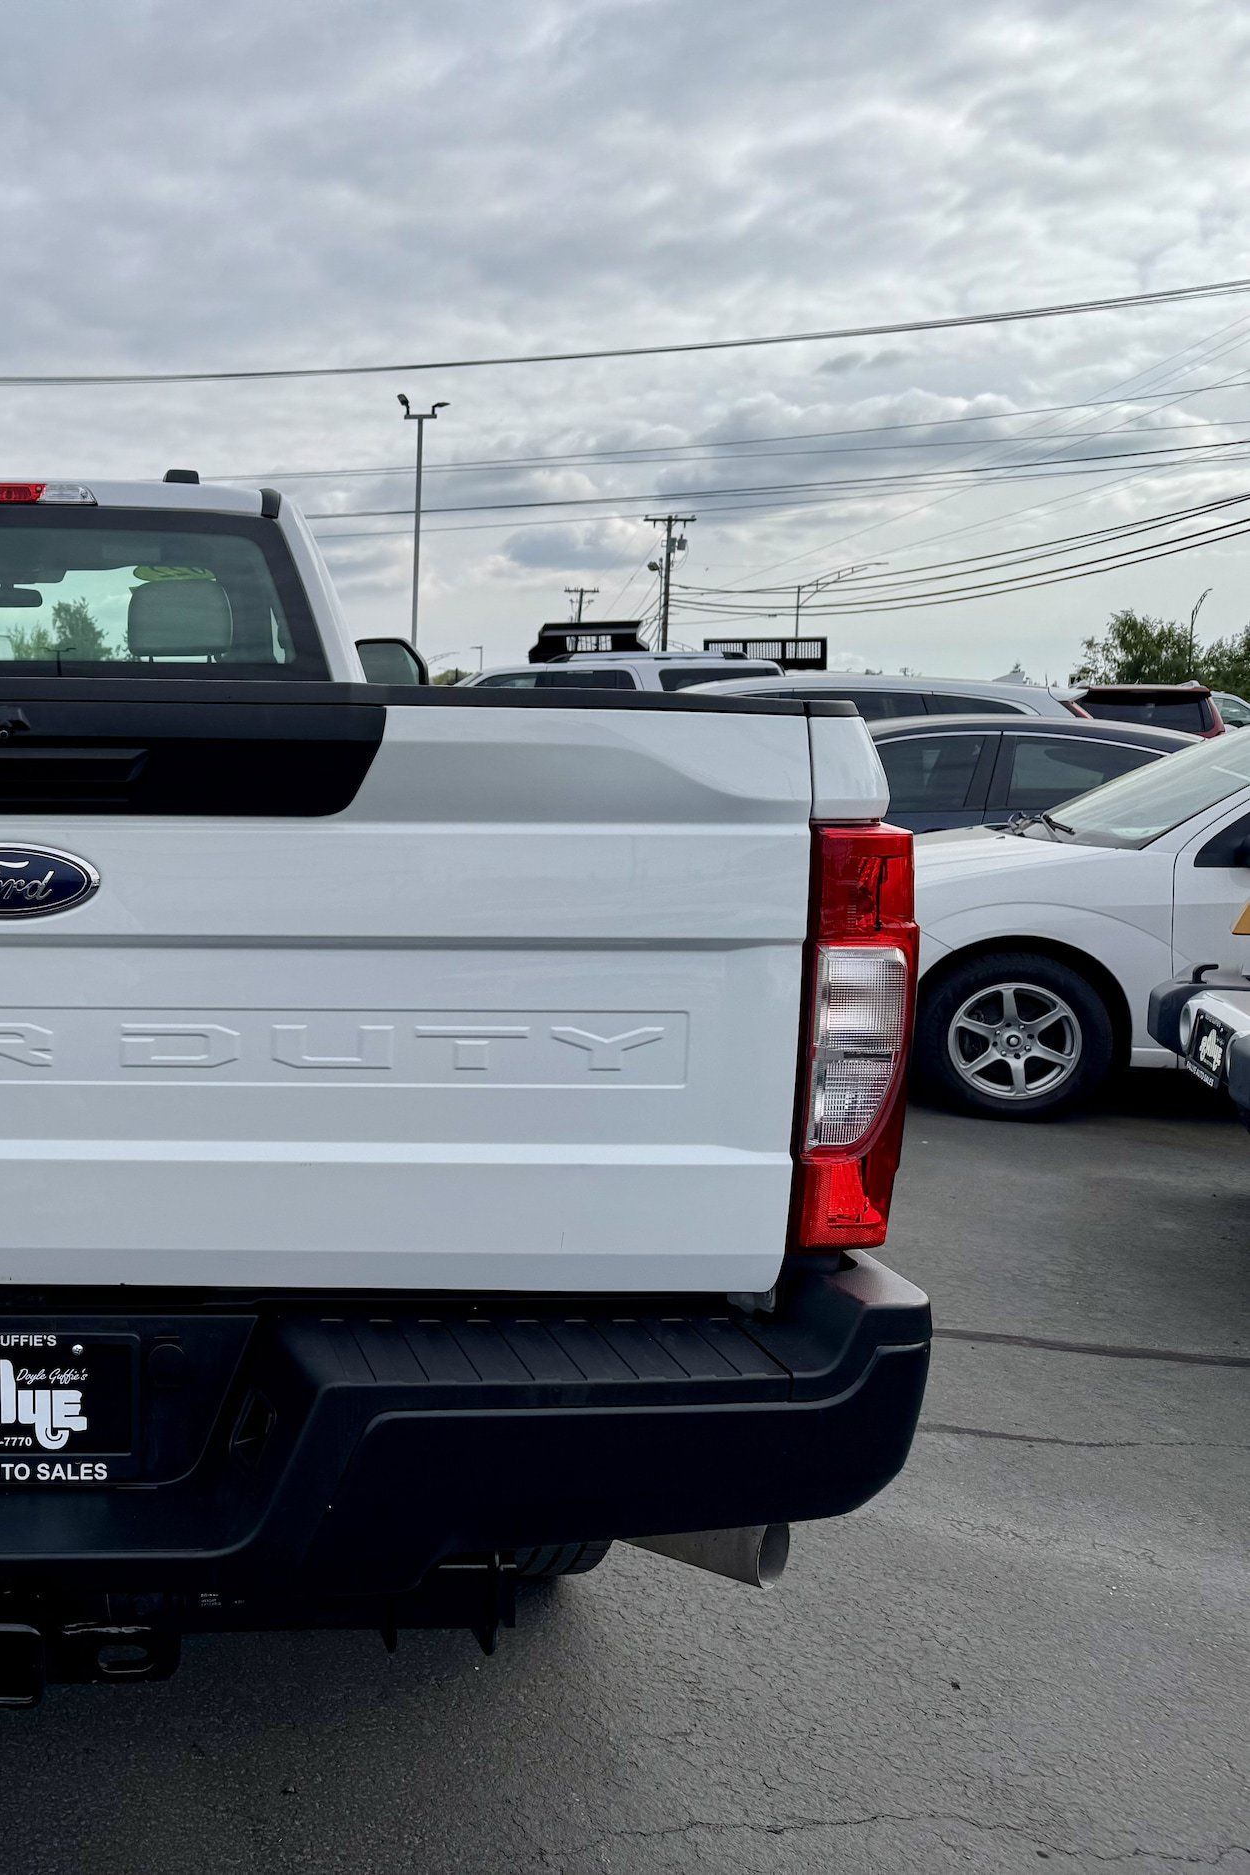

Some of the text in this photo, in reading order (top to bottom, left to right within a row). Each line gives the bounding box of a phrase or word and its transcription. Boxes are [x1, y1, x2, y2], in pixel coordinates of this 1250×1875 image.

[120, 1023, 664, 1071] DUTY
[16, 1367, 88, 1385] Doyle Guffie's
[36, 1463, 108, 1481] SALES
